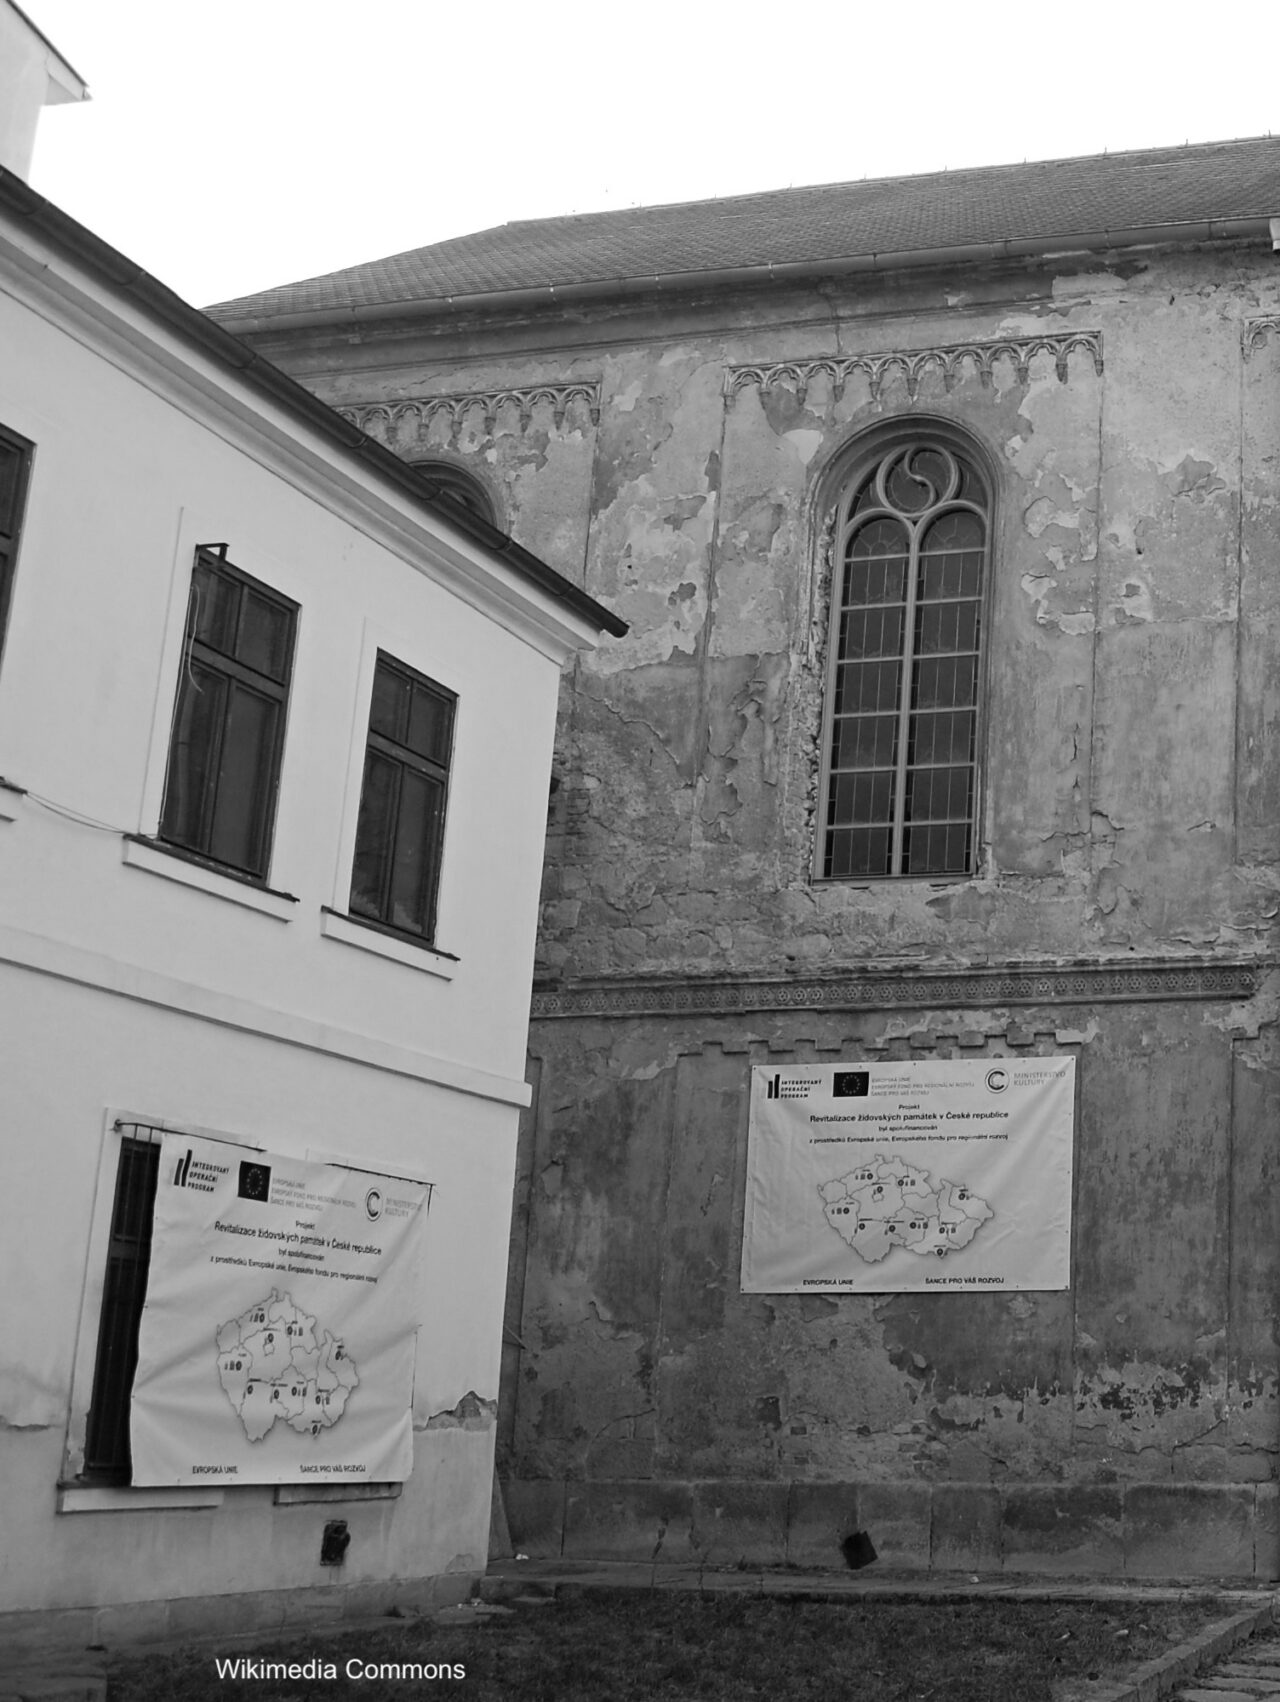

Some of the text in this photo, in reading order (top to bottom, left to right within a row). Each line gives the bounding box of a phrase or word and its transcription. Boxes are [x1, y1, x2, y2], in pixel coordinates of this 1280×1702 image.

[1014, 1071, 1066, 1079] MINISTERSTVO
[810, 1114, 856, 1122] Revitalizace
[857, 1113, 902, 1122] židovských
[903, 1112, 937, 1121] památek
[945, 1111, 971, 1120] České
[972, 1110, 1009, 1120] republice
[187, 1182, 215, 1192] PROGRAM
[295, 1220, 316, 1230] Projekt
[214, 1220, 257, 1237] Revitalizace
[258, 1227, 299, 1243] židovských
[300, 1235, 325, 1247] památek
[331, 1238, 351, 1251] České
[351, 1243, 382, 1256] republice
[278, 1248, 287, 1257] byl
[330, 1271, 339, 1279] pro
[802, 1278, 837, 1286] EVROPSKÁ
[964, 1276, 977, 1284] VÁŠ
[978, 1276, 1005, 1284] ROZVOJ
[320, 1464, 332, 1473] PRO
